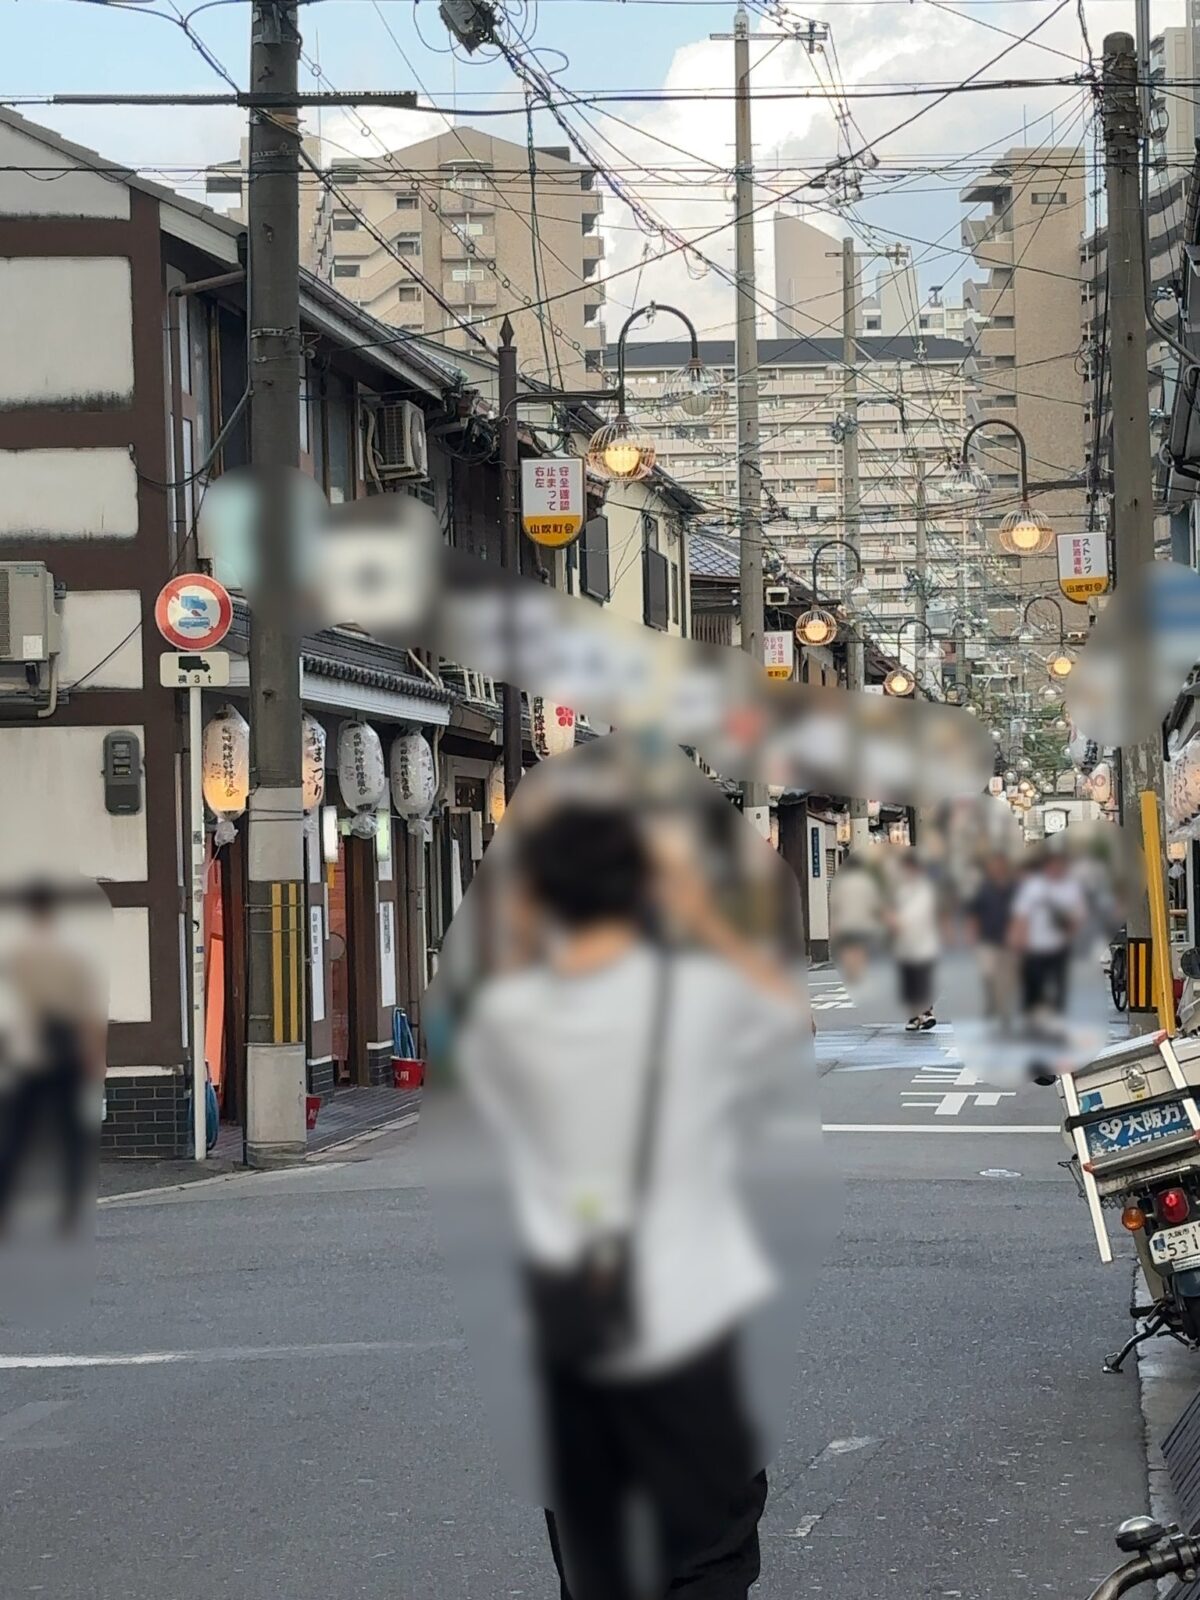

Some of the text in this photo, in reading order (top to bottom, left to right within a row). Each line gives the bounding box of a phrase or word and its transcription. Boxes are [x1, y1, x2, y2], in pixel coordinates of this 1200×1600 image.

[535, 467, 545, 488] 右左
[547, 467, 556, 511] 止まって
[530, 524, 574, 534] 山吹町会
[1082, 538, 1092, 574] ストップ
[1124, 1104, 1188, 1137] 大阪ガ
